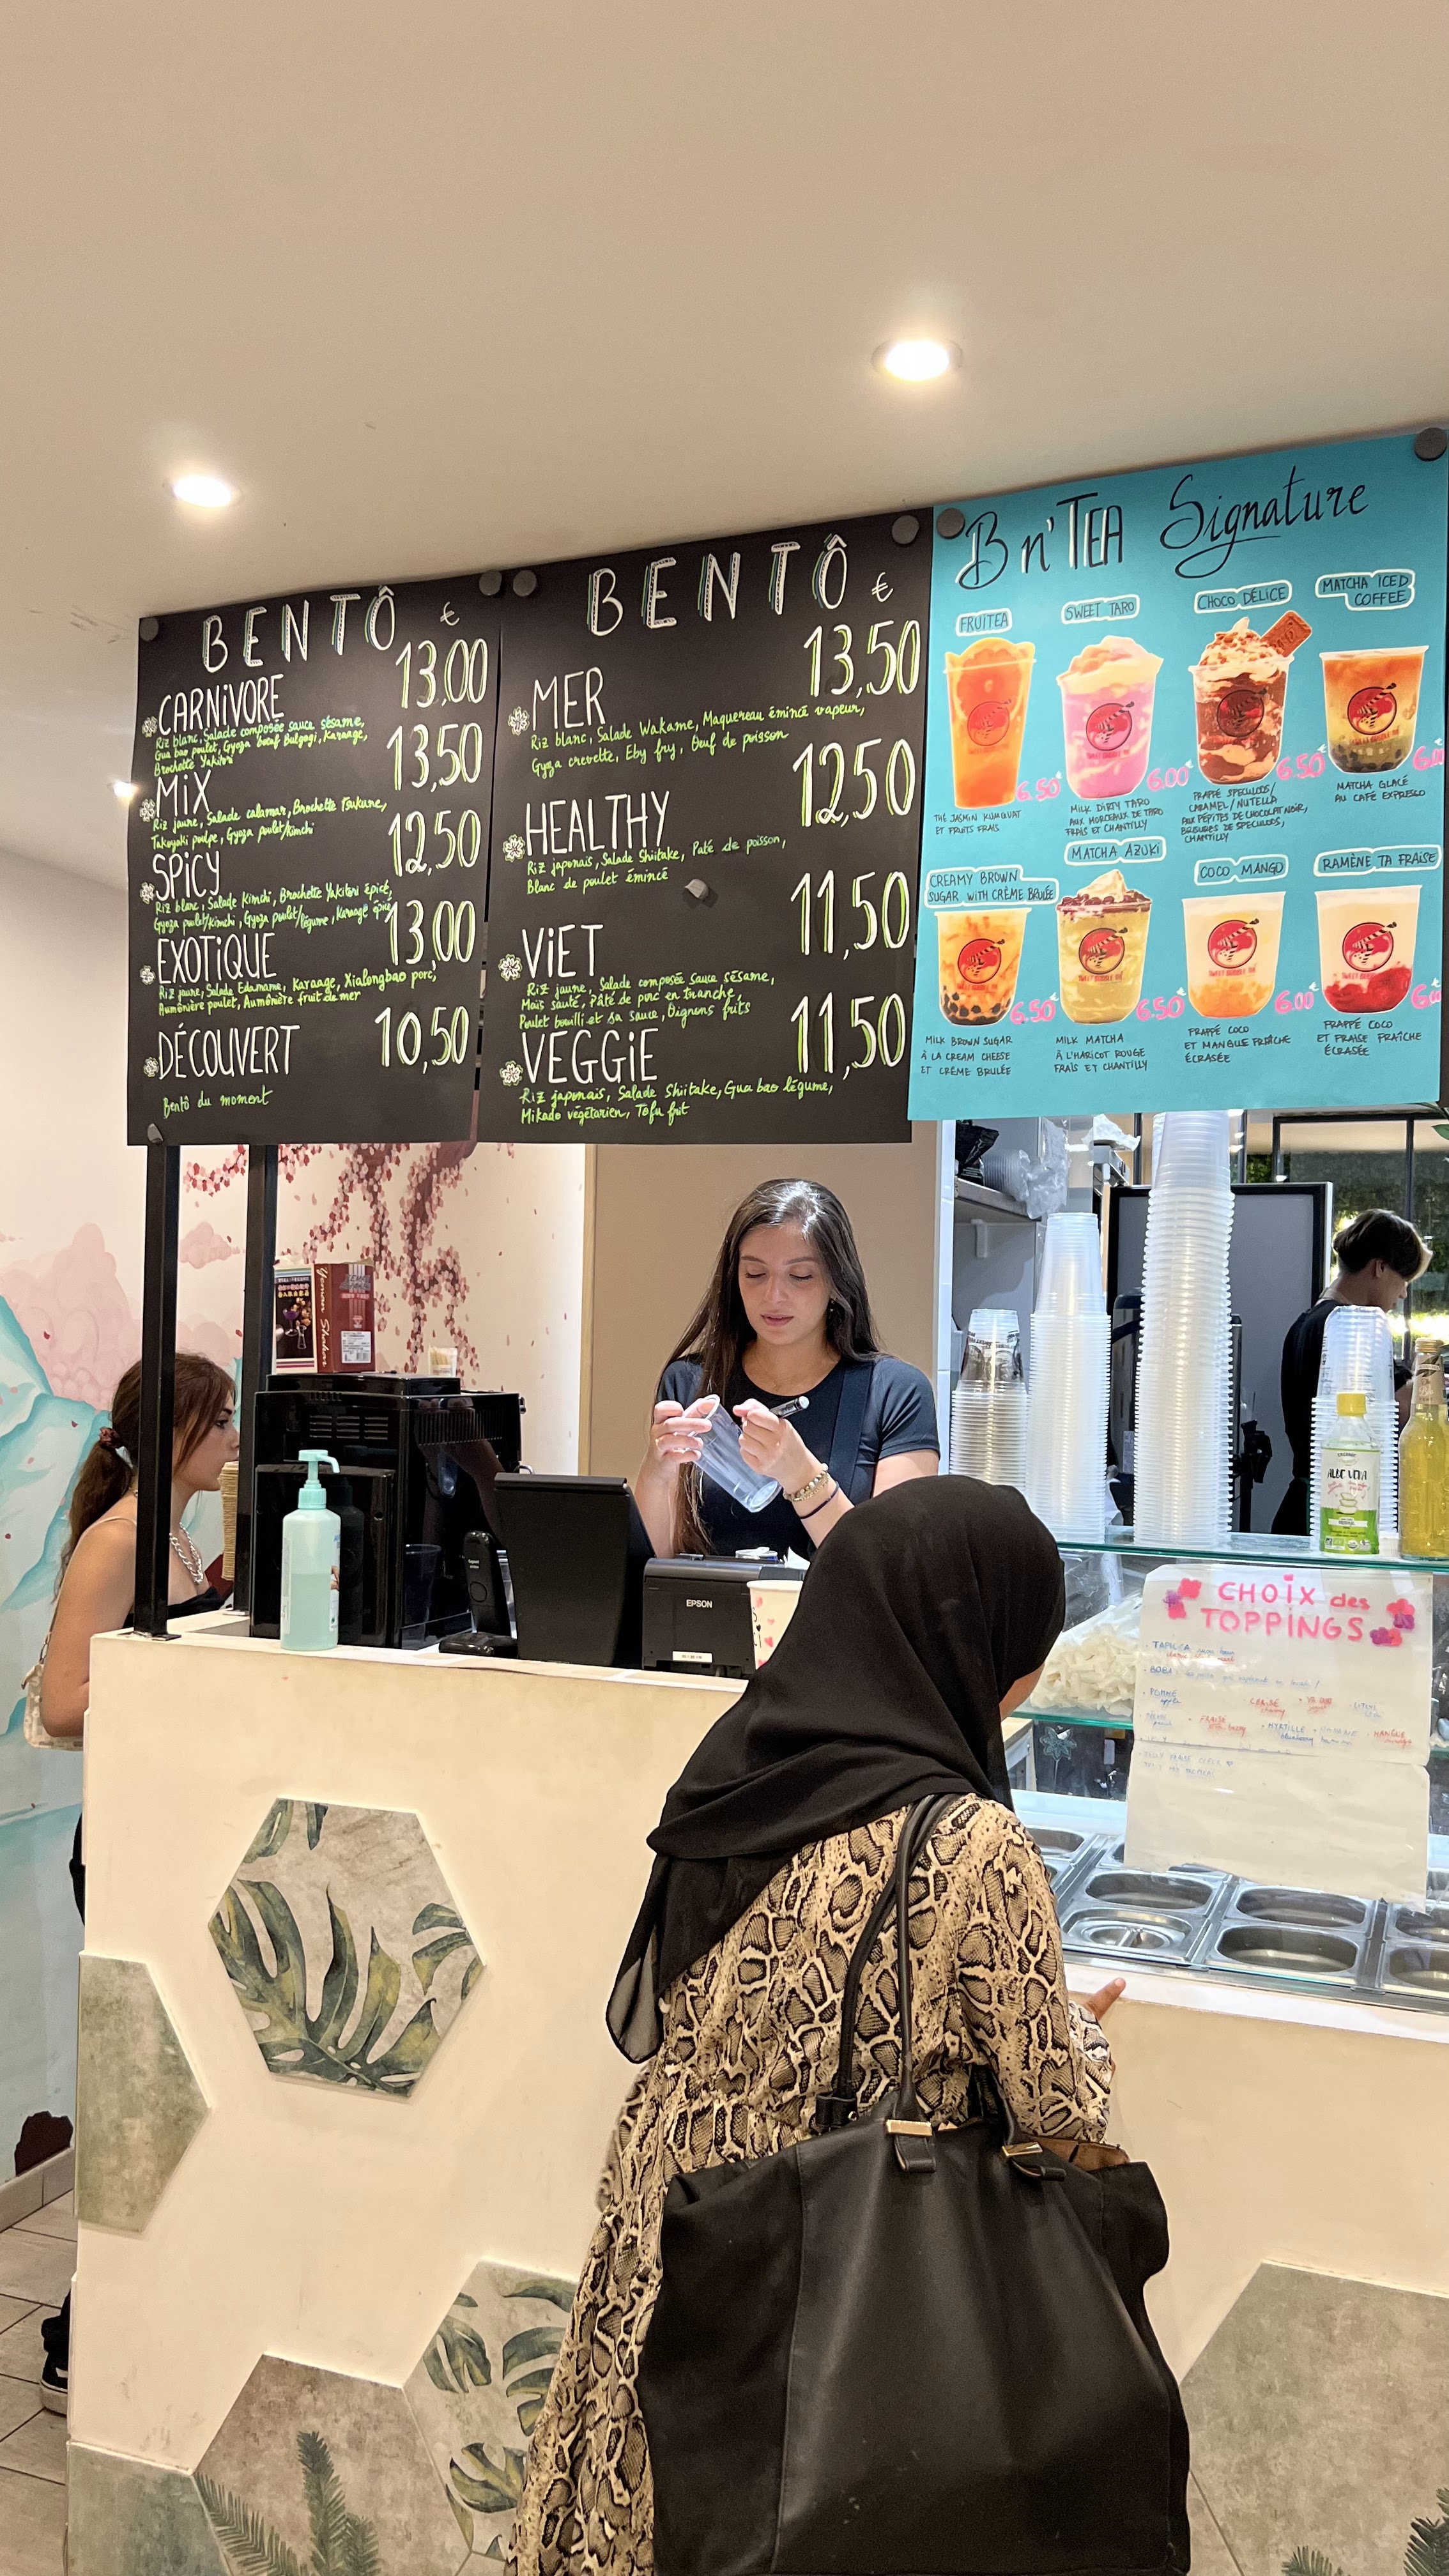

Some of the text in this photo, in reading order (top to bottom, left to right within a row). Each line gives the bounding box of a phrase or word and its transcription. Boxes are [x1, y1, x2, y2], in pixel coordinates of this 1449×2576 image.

[1160, 465, 1369, 578] Signature
[586, 533, 893, 636] BENTÔ €
[1322, 577, 1368, 592] MATCHA
[1198, 595, 1236, 610] CHOCO
[1354, 590, 1407, 606] COFFEE
[1066, 601, 1135, 621] SWEET TARO
[203, 586, 459, 673] BENTÔ €
[804, 620, 921, 698] 13,50
[395, 639, 488, 709] 13,00
[532, 667, 606, 731] MER
[203, 725, 236, 742] Salade
[532, 703, 865, 751] Riz Salade Wakame, Maquereau émincé vapeur,
[223, 740, 251, 755] Gyoza
[387, 723, 482, 792] 13,50
[532, 730, 789, 779] Gyoza crevette, Eby fry, de poisson
[154, 754, 234, 777] Brochette Yakitori
[792, 739, 916, 827] 12,50
[1337, 775, 1409, 790] MATCHA GLACÉ
[1353, 791, 1376, 802] CAFÉ
[206, 795, 387, 826] Salade Brochette Tsukune,
[983, 810, 1021, 821] KUMQUAT
[526, 791, 670, 856] HEALTHY
[151, 827, 254, 853] Takoyaki poulpe, Gyoza
[388, 809, 480, 877] 12,50
[527, 835, 786, 877] Riz japonais, Salade Shiitake, de poisson,
[1072, 846, 1117, 860] MATCHA
[1322, 852, 1371, 871] RAMÈNE
[1377, 855, 1392, 867] TA
[527, 867, 668, 894] Blanc de poulet émincé
[930, 870, 1018, 887] CREAMY BROWN
[1200, 861, 1283, 878] COCO MANGO
[208, 882, 359, 910] Salade Brochette Yakitori
[928, 886, 1023, 902] SUGAR CRÈME
[791, 870, 909, 960] 11,50
[385, 899, 476, 970] 13,00
[206, 968, 407, 997] Salade Edamame, Karaage, Xialongbao
[526, 983, 549, 996] Riz
[599, 974, 631, 991] Salade
[638, 972, 685, 992] composée
[159, 991, 361, 1016] Aumônière poulet, Aumônière fruit mer
[590, 984, 742, 1008] Pâté de tranche,
[519, 997, 751, 1029] Poulet et Oignons frits
[1323, 1017, 1393, 1030] FRAPPÉ COCO
[375, 1006, 470, 1074] 10,50
[790, 993, 906, 1080] 11,50
[951, 1036, 1013, 1046] BROWN SUGAR
[1085, 1034, 1124, 1045] MATCHA
[1188, 1024, 1249, 1037] FRAPPÉ COCO
[1317, 1034, 1330, 1043] ET
[1335, 1034, 1368, 1043] FRAISE
[158, 1023, 300, 1080] DÉCOUVERT
[1115, 1048, 1146, 1058] ROUGE
[1202, 1038, 1249, 1048] MANGUE
[1324, 1044, 1370, 1056] ÉCRASÉE
[946, 1052, 1010, 1061] CREAM CHEESE
[1184, 1052, 1230, 1063] ÉCRASÉE
[976, 1064, 1011, 1077] BRULÉE
[1084, 1064, 1098, 1073] ET
[163, 1084, 273, 1119] Bentô du moment
[519, 1076, 833, 1108] Riz japonais, Salade Shiitake, Gua bao légume,
[521, 1100, 690, 1126] Mikado végétarien, Tofu frit
[1348, 1470, 1368, 1480] VERA
[686, 1599, 712, 1608] EPSON
[1330, 1593, 1370, 1611] des
